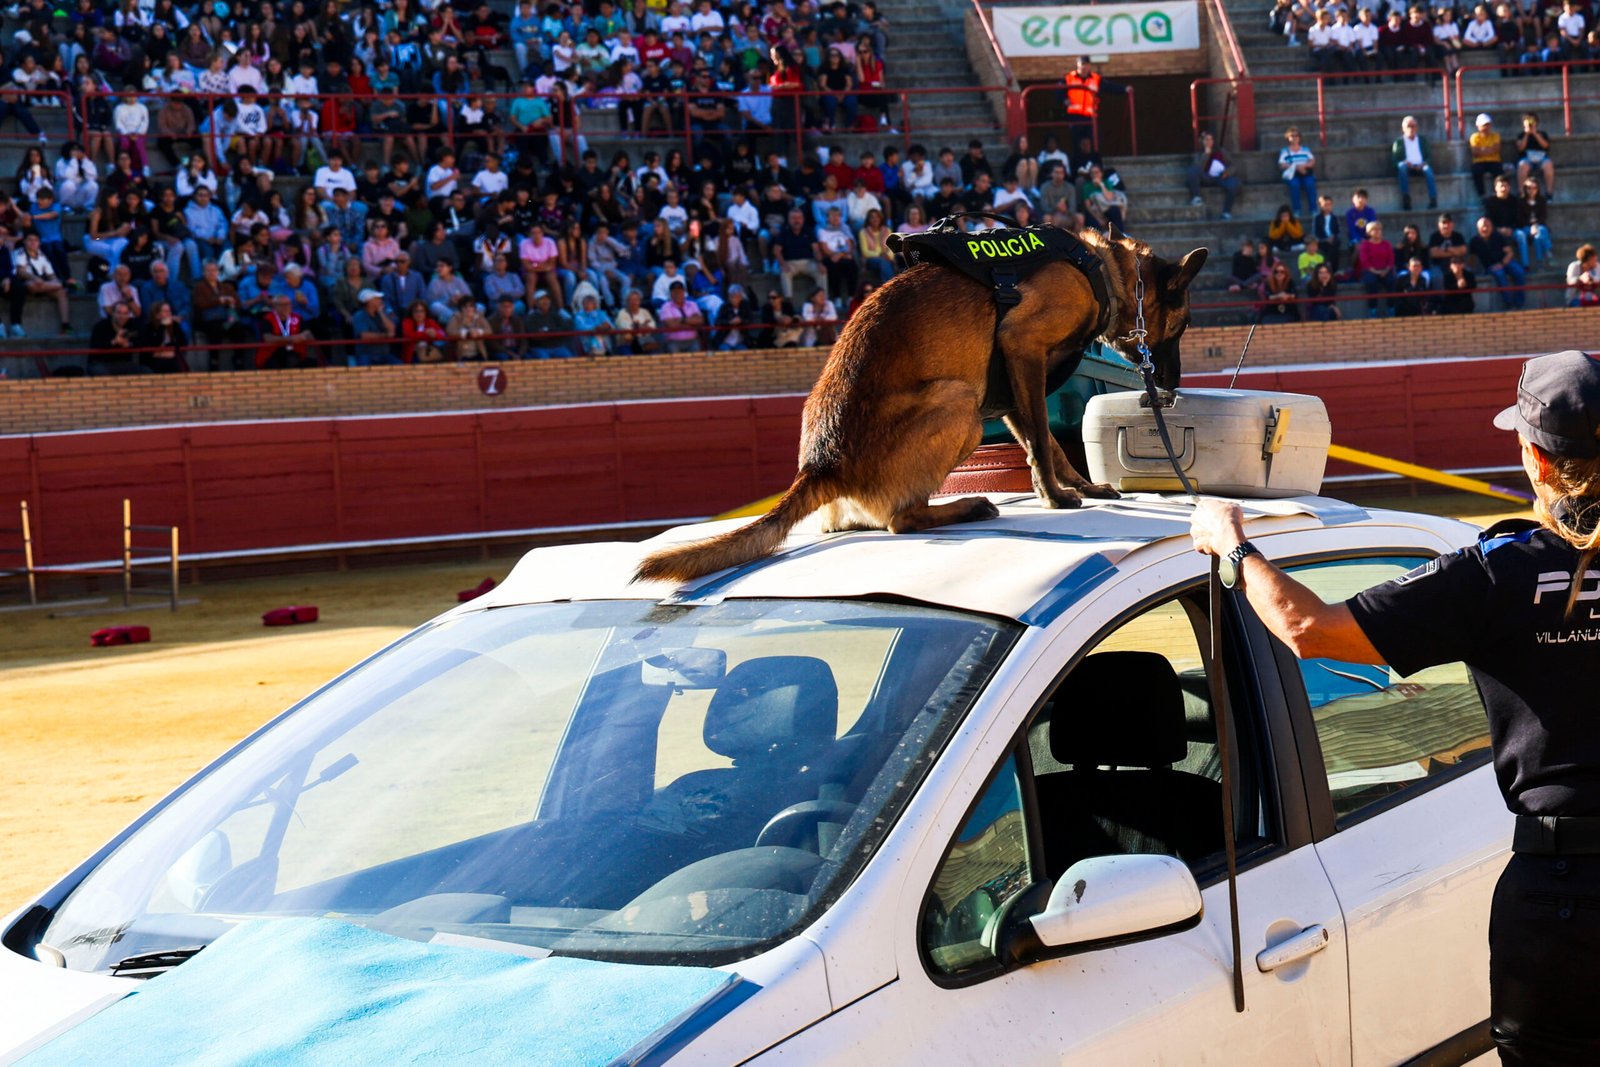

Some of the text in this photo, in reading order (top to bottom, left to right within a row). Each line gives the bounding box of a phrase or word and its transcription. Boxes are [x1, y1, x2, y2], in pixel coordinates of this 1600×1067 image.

[1021, 11, 1172, 47] erena
[967, 232, 1045, 259] POLICÍA
[483, 369, 499, 394] 7
